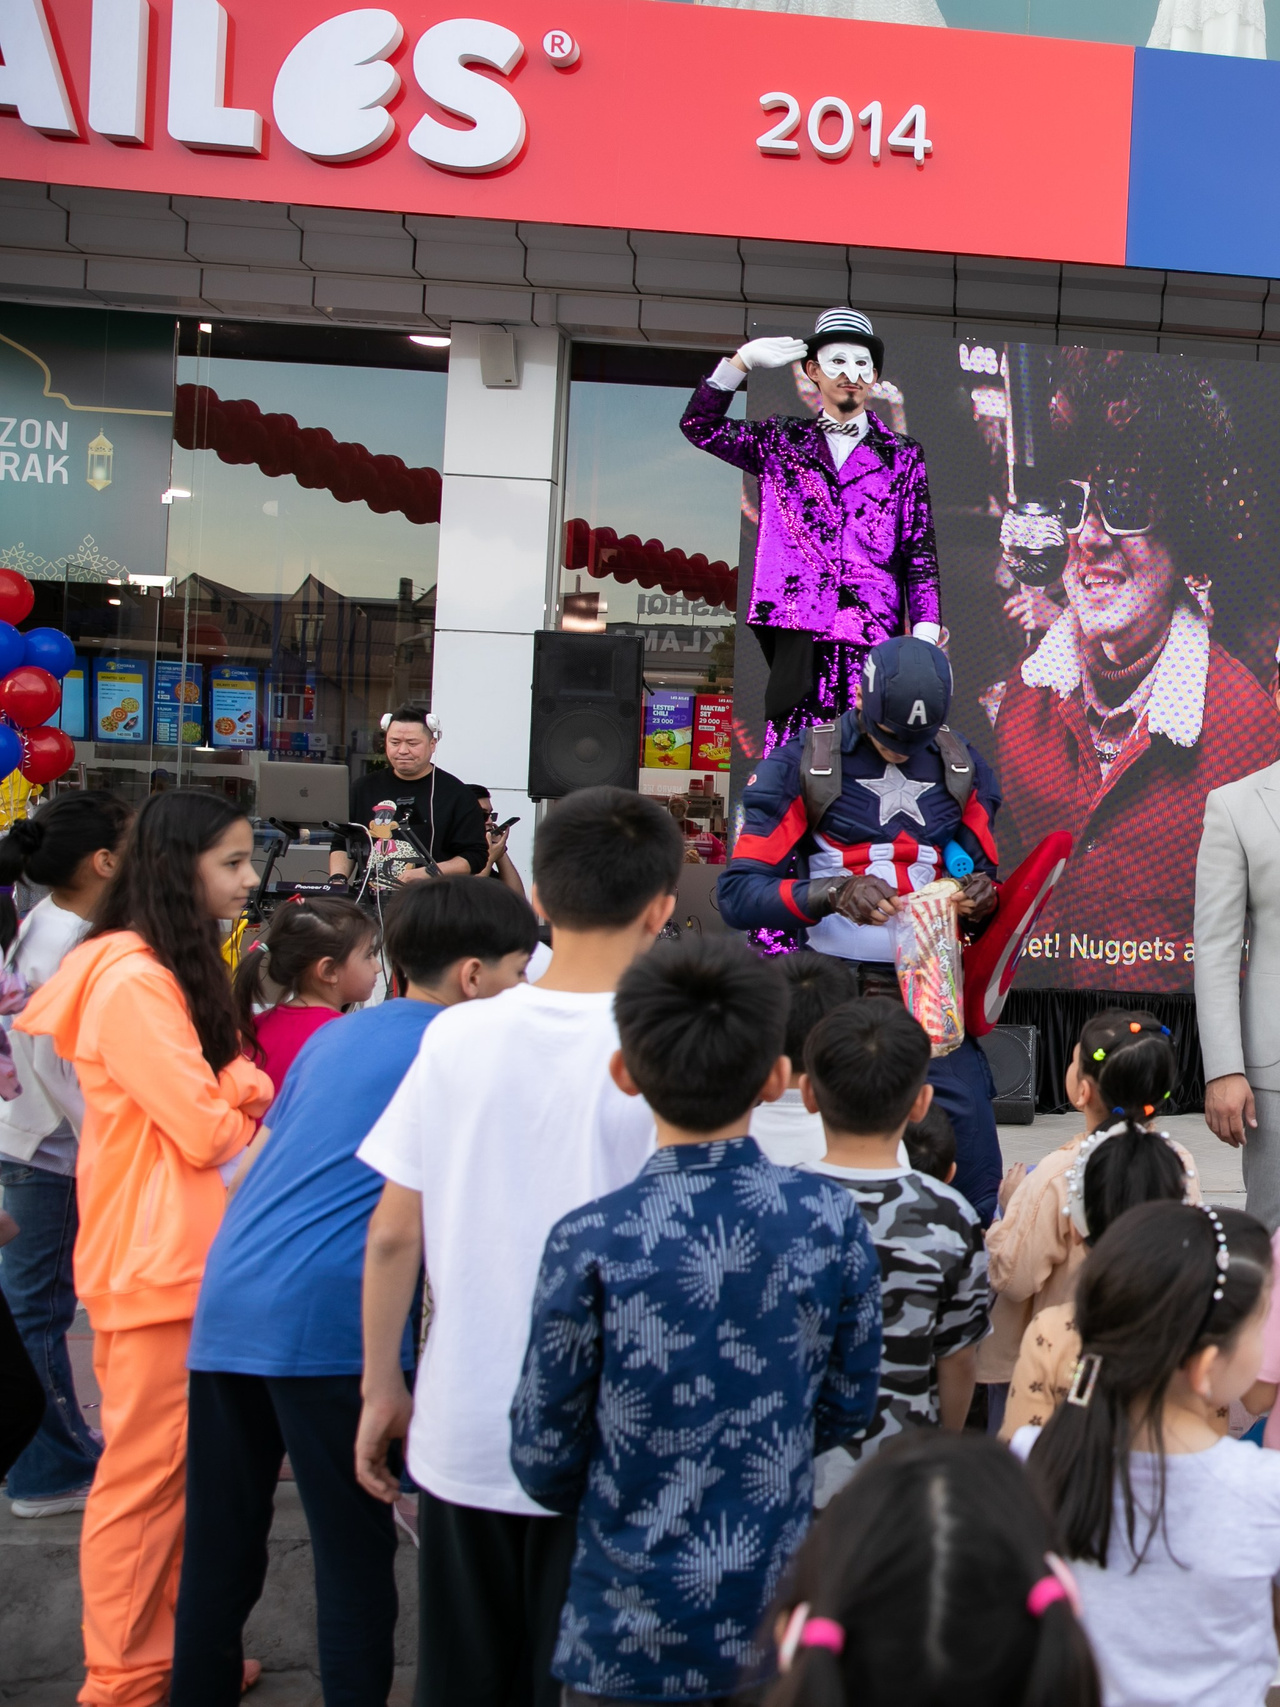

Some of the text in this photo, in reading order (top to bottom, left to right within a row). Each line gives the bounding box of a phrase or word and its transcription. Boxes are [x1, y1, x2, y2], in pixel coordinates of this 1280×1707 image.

[756, 91, 933, 166] 2014
[907, 700, 928, 725] A
[1070, 934, 1175, 966] Nuggets
